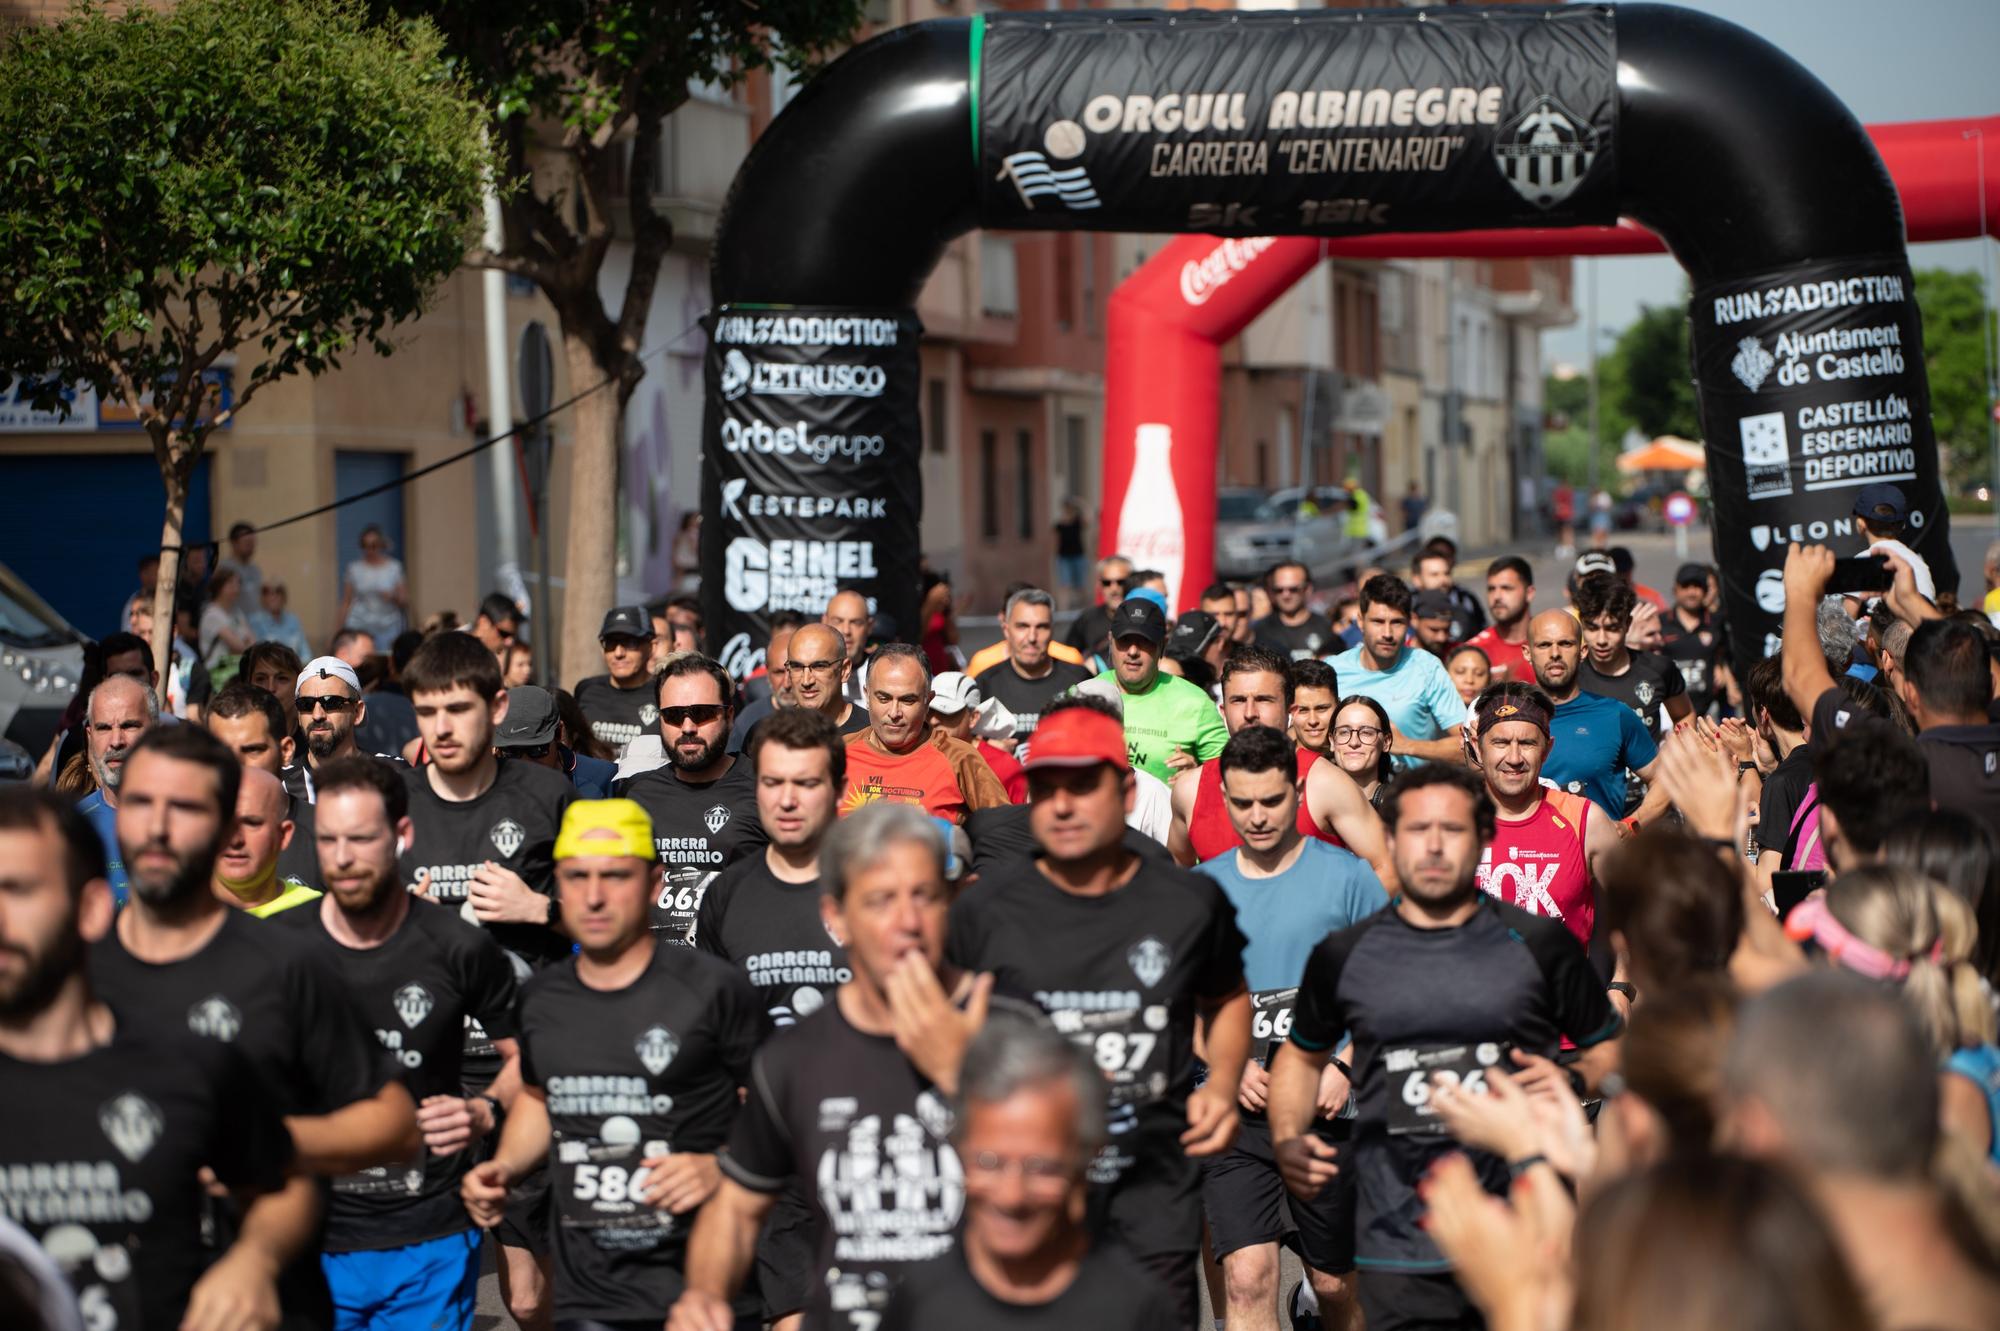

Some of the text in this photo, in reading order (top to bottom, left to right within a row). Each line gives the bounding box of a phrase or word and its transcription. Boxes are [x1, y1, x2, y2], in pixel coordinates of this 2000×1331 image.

[1084, 86, 1503, 134] ORGULL ALBINEGRE
[1150, 139, 1268, 178] CARRERA
[1774, 322, 1901, 364] Ajuntament
[1777, 347, 1905, 386] de Castelló
[1801, 422, 1912, 456] ESCENARIO
[1804, 448, 1916, 481] DEPORTIVO
[1772, 510, 1925, 545] LEONO
[746, 950, 832, 972] CARRERA
